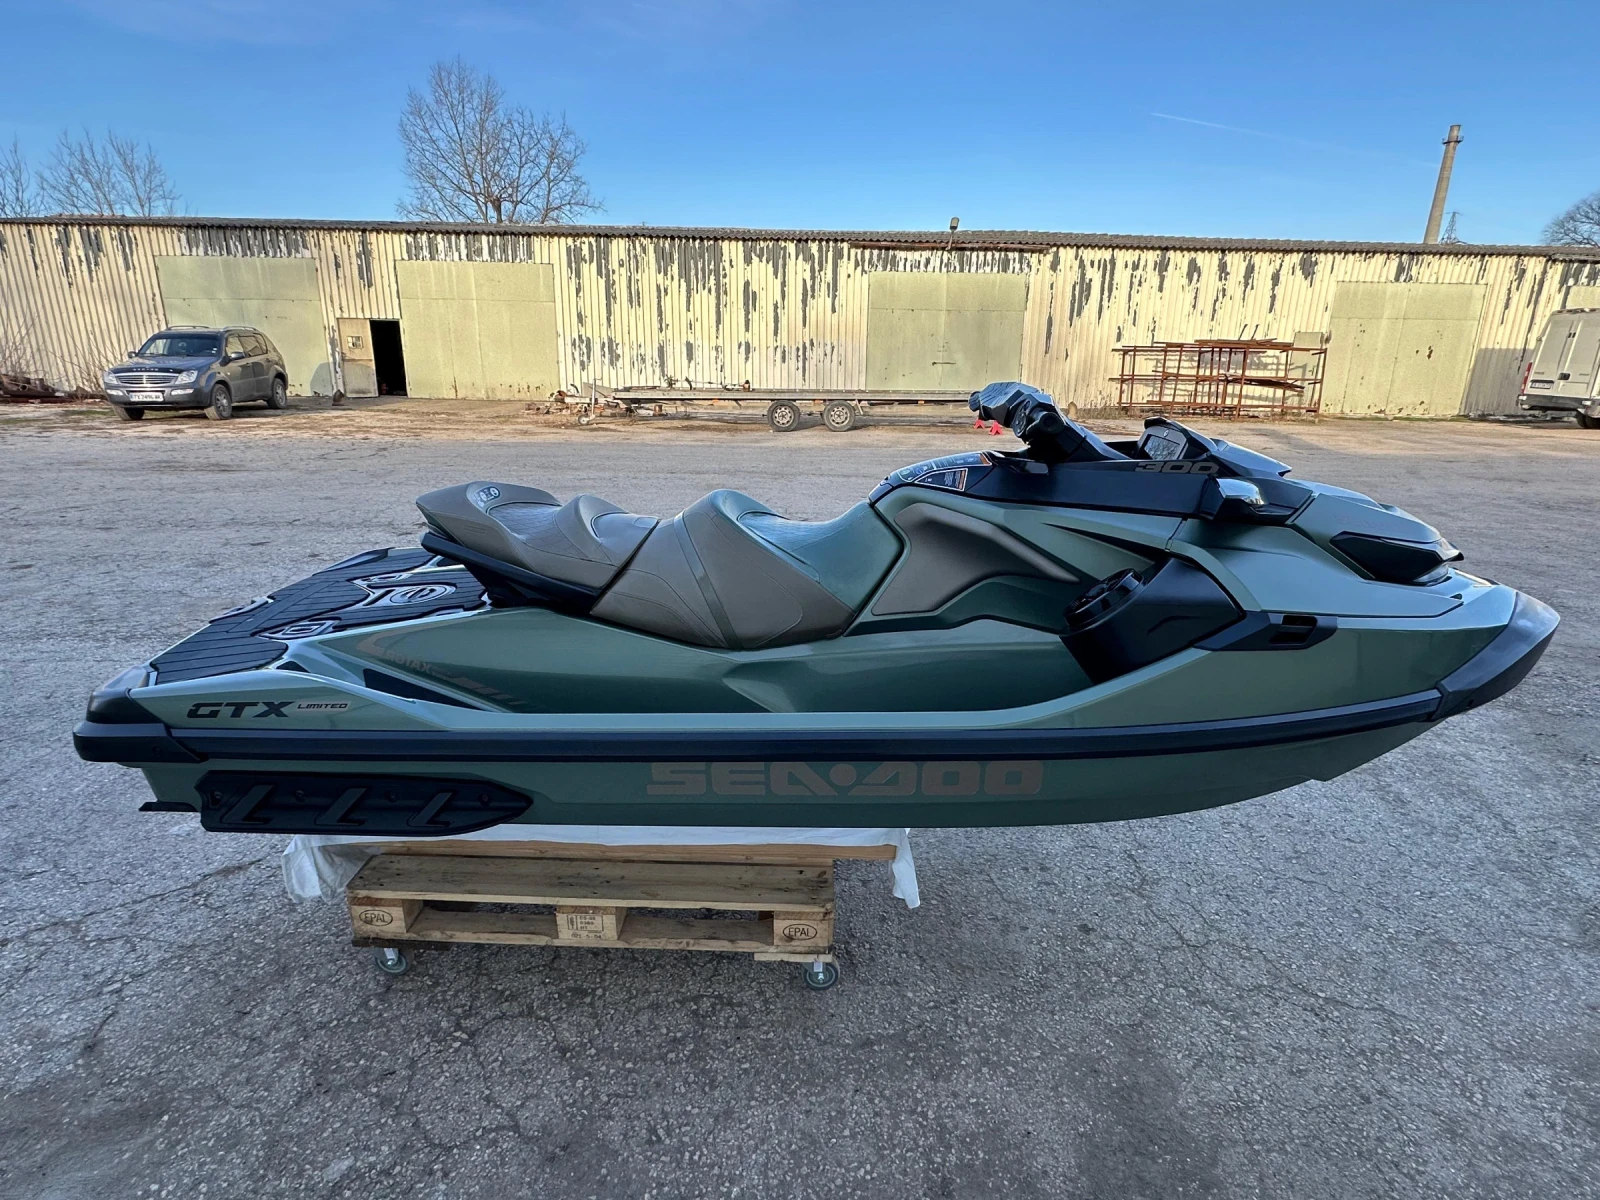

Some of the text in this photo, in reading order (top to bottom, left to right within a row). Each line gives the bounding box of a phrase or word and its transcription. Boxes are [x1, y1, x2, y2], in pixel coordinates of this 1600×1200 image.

[1135, 461, 1219, 474] 300
[386, 650, 433, 675] ROTAX
[187, 701, 349, 719] GTX LIMITED
